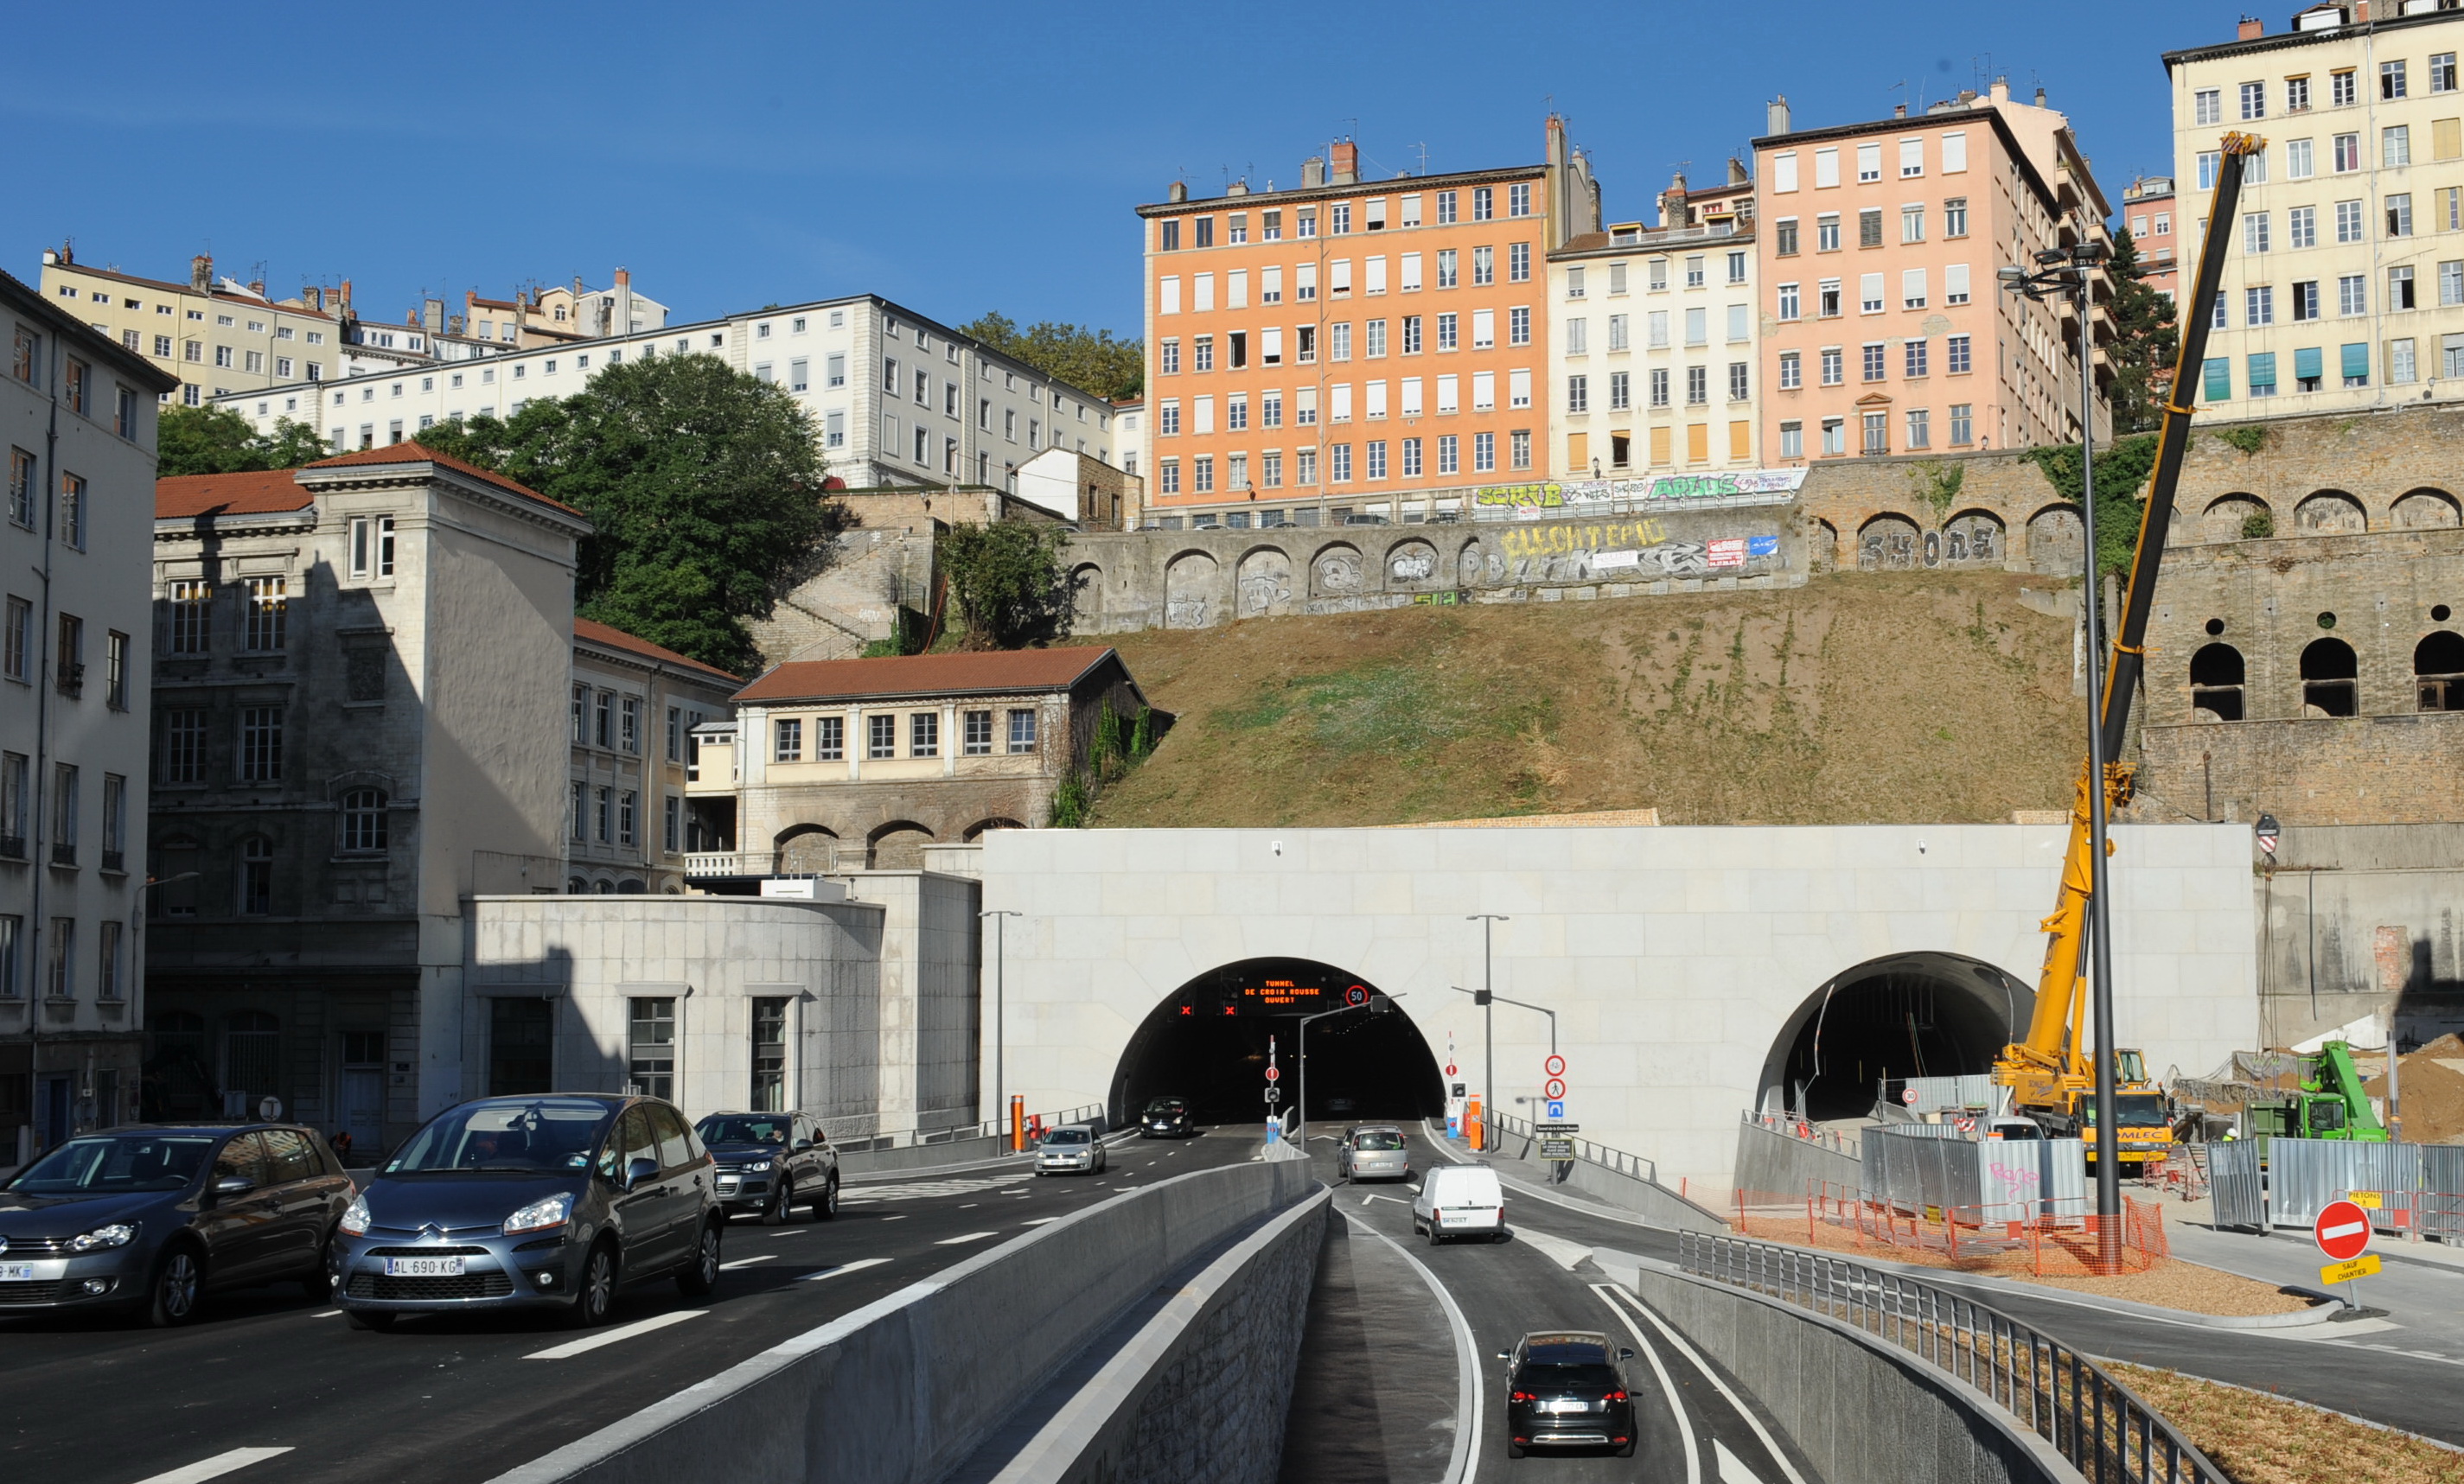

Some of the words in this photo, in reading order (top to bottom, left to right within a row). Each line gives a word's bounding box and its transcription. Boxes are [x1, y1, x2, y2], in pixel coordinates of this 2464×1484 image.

[1477, 484, 1563, 507] SCRIB
[1351, 991, 1363, 1001] 50
[2342, 1261, 2359, 1271] SAUF
[2337, 1268, 2367, 1280] CHANTIER
